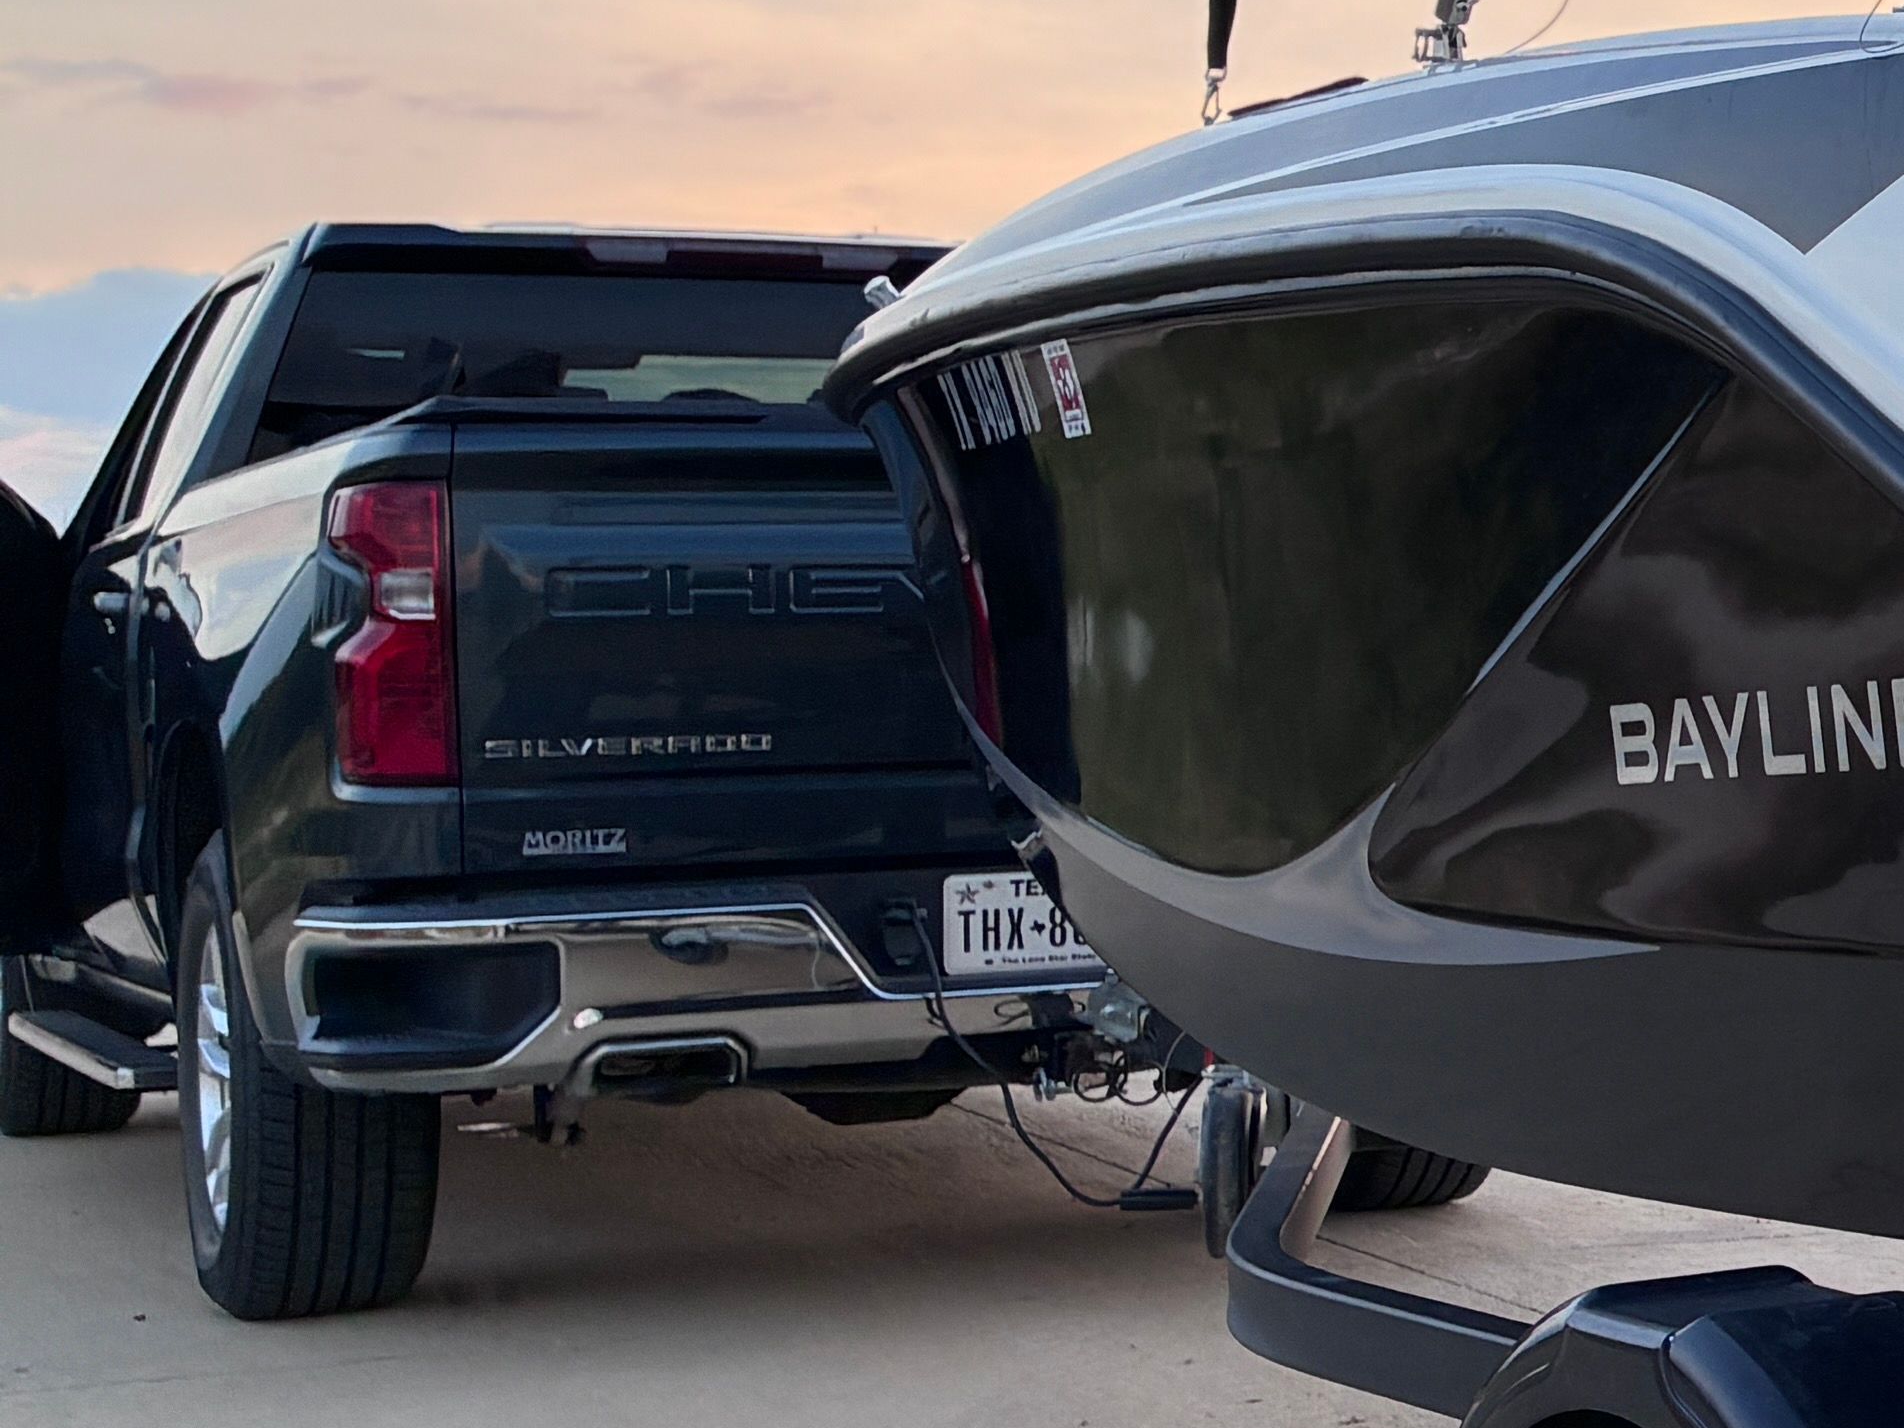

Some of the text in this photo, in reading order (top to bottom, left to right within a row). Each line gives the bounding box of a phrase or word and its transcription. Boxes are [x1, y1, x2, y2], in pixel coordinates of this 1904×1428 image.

[484, 732, 772, 759] SILVERADO
[523, 827, 627, 856] MORITZ
[958, 907, 1025, 953] THX
